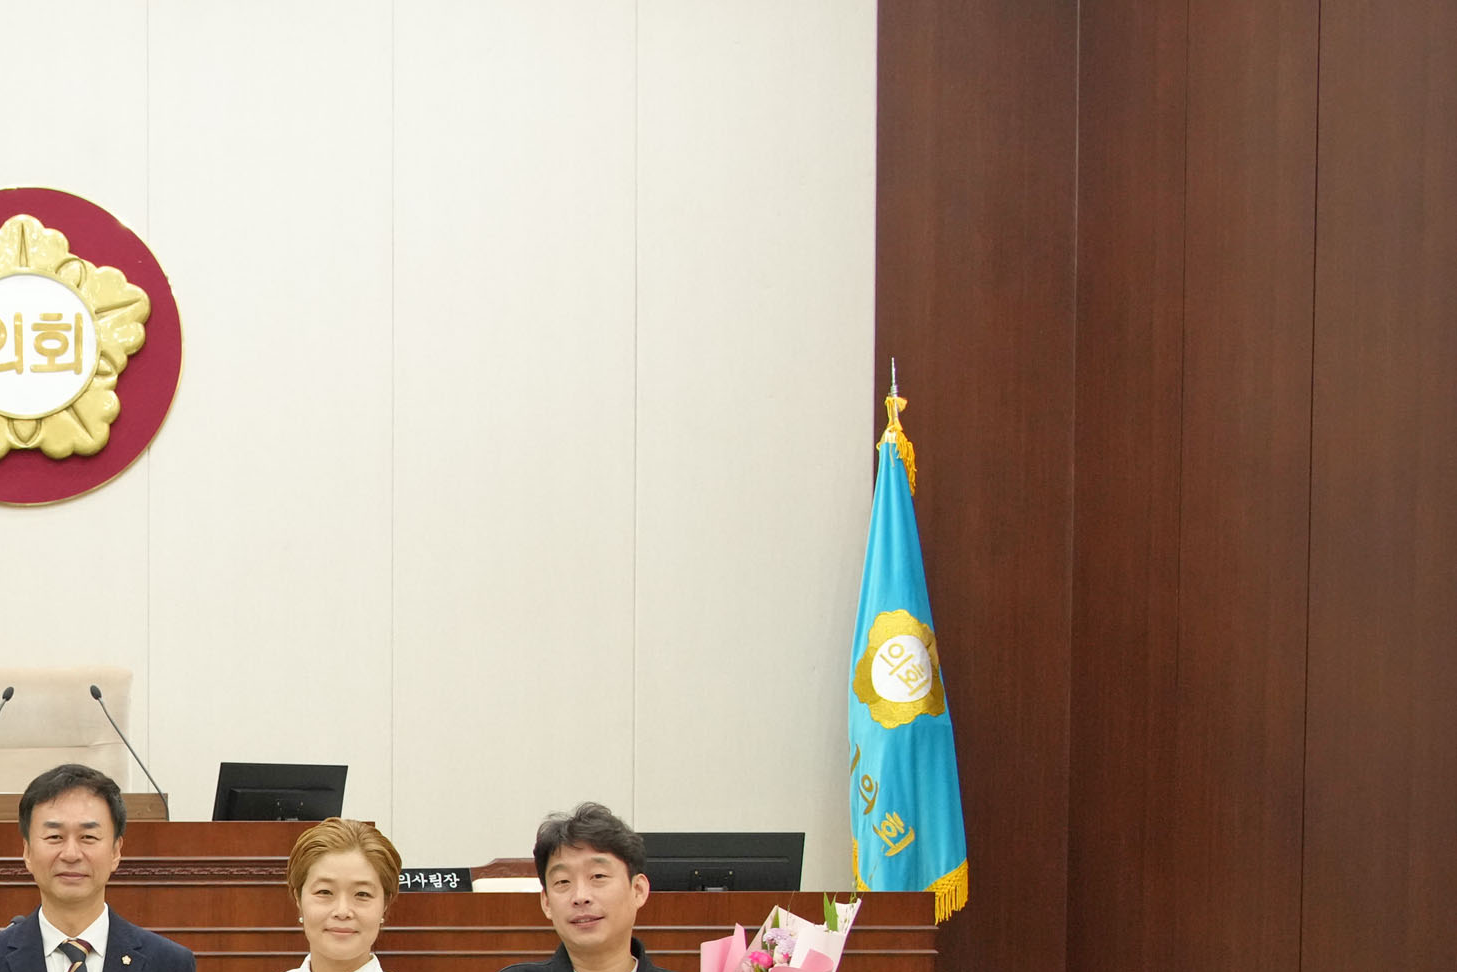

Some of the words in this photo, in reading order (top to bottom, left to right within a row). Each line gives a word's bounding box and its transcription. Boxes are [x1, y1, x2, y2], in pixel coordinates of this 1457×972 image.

[879, 643, 931, 696] 의회
[850, 743, 916, 857] 의회
[398, 872, 461, 889] 의사팀장
